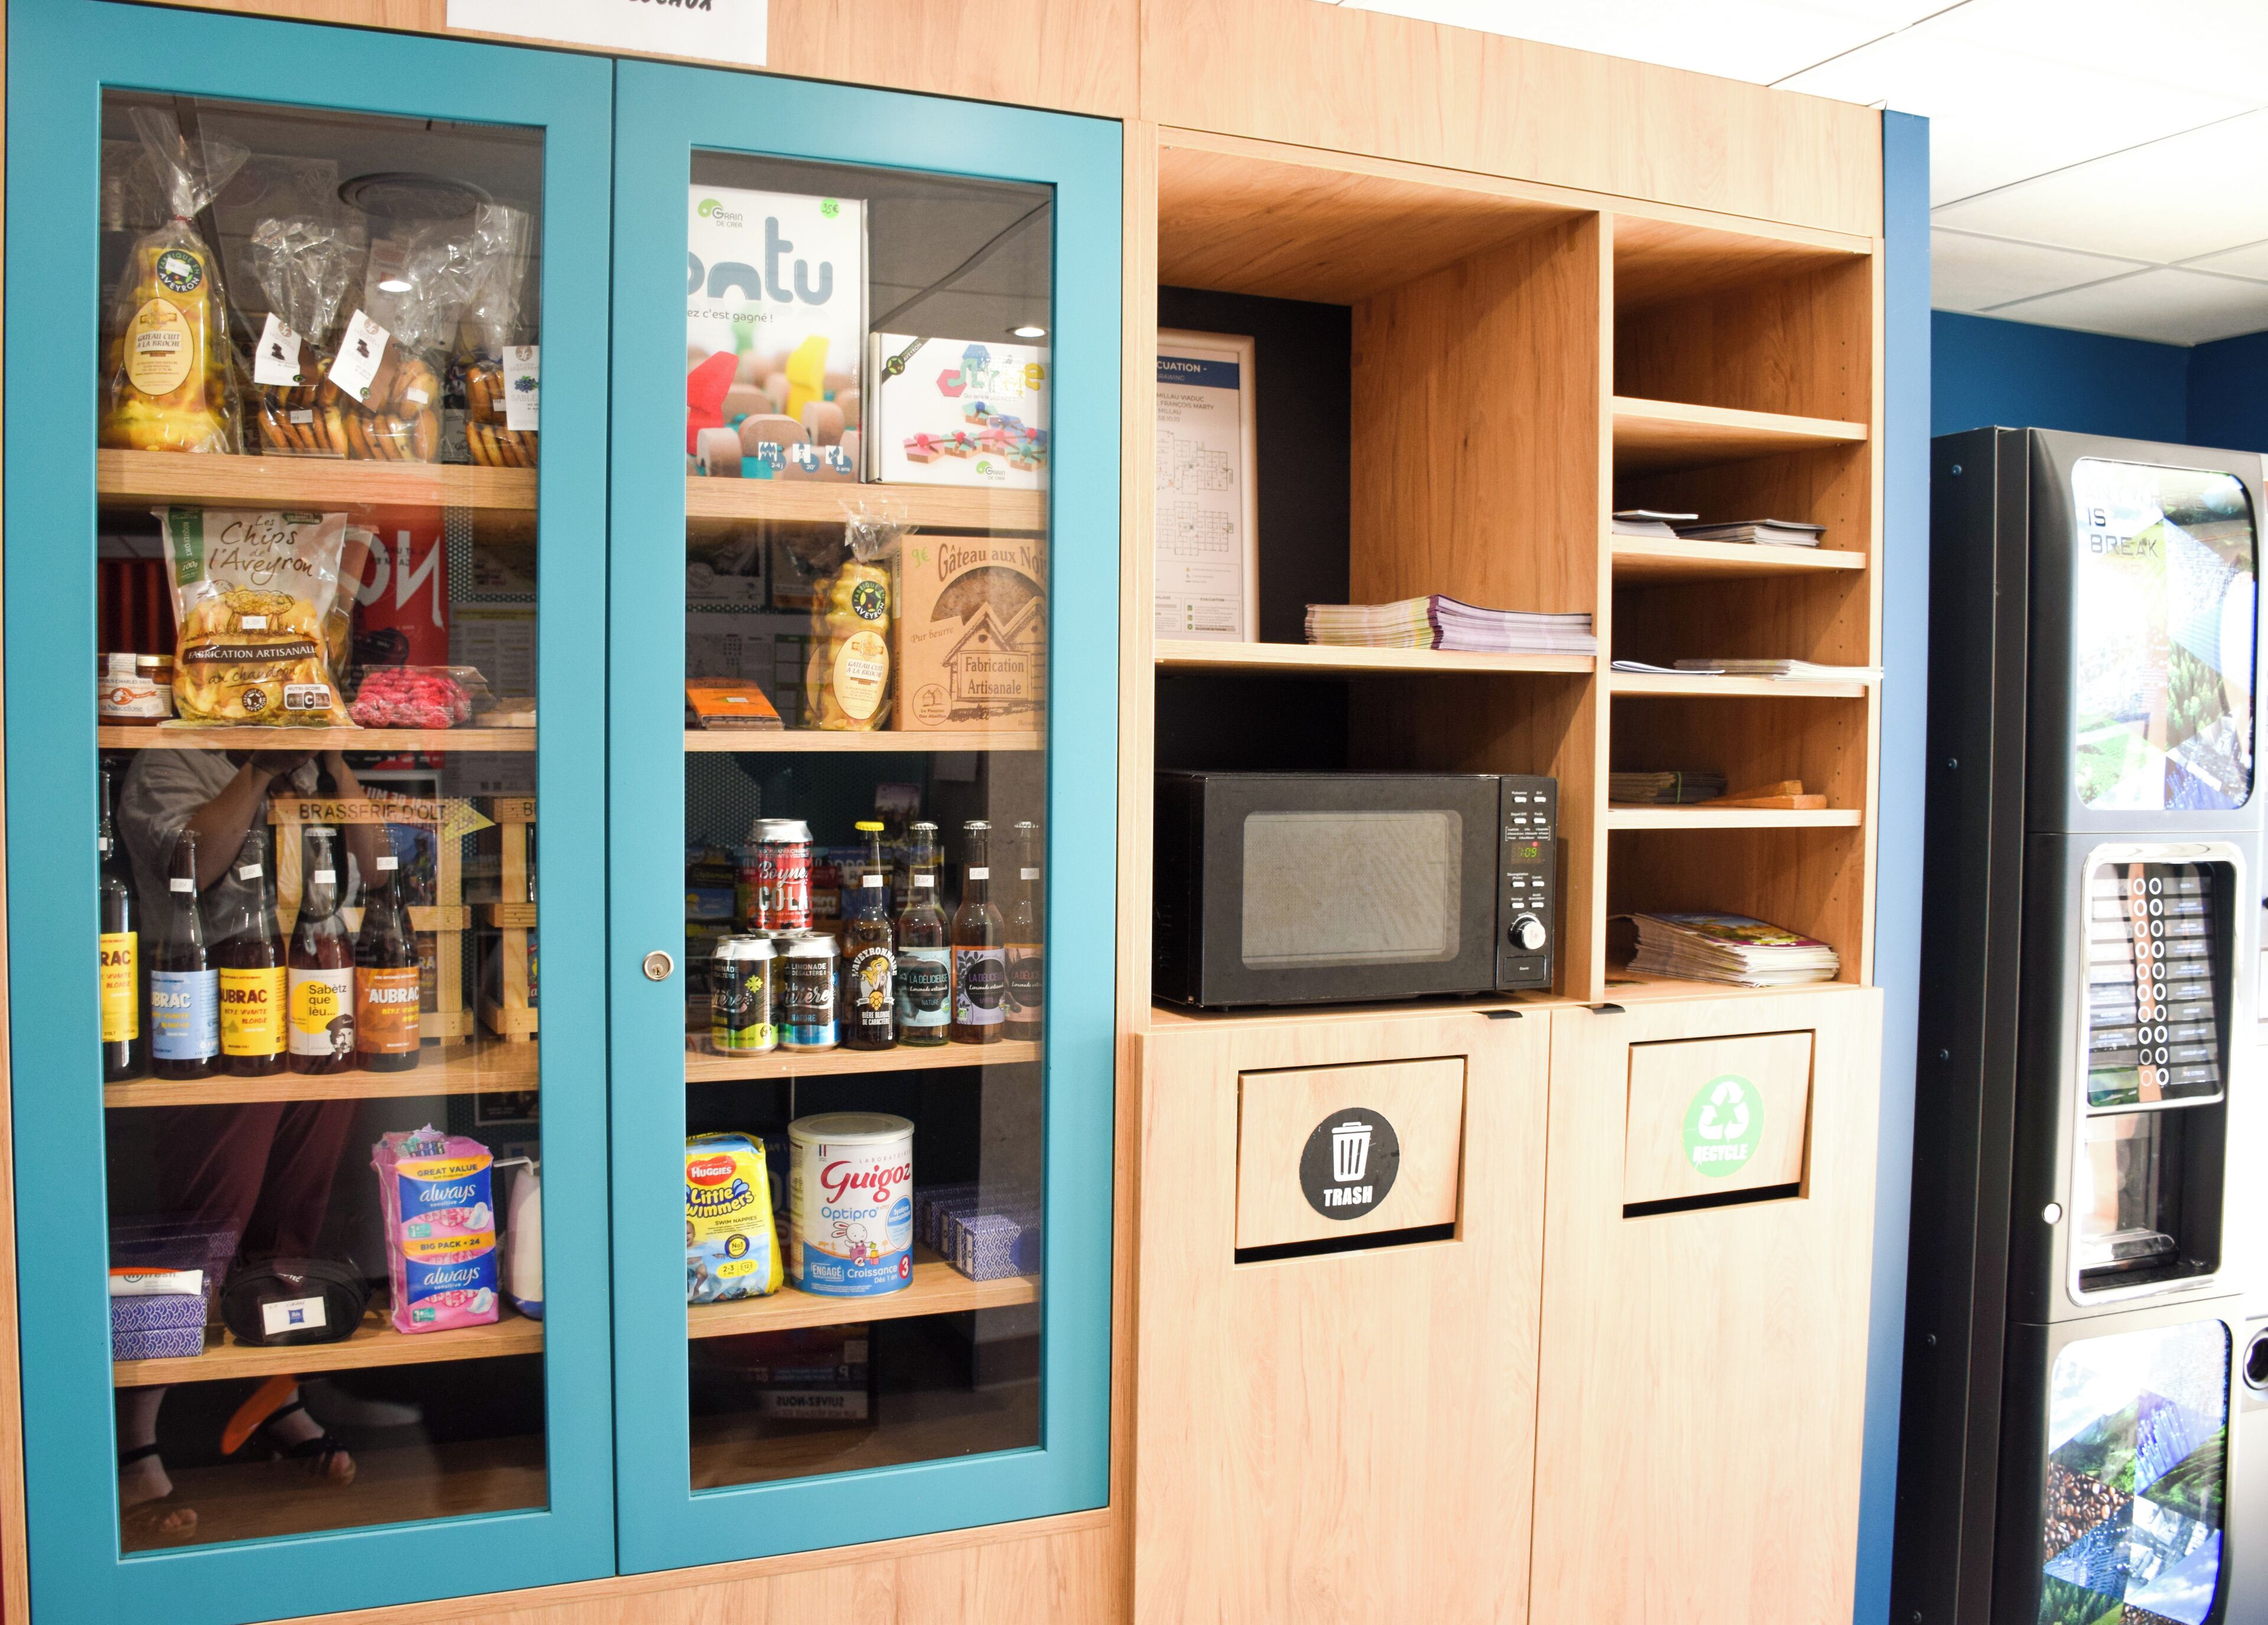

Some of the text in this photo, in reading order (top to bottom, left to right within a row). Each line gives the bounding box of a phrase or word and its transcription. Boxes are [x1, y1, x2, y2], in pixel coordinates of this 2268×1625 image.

[822, 203, 839, 214] 35€
[159, 273, 200, 292] AVEYRON
[703, 309, 729, 319] c'est
[733, 313, 767, 323] gagné
[138, 334, 180, 342] GATEAU CUIT
[255, 515, 275, 527] Les
[2087, 507, 2106, 527] IS
[221, 521, 298, 552] Chips
[250, 548, 265, 557] de
[2090, 534, 2159, 558] BREAK
[182, 561, 198, 572] 100g
[209, 547, 312, 586] l'Aveyron
[938, 543, 986, 582] Gâteau
[991, 550, 1016, 563] aux
[855, 602, 884, 620] AVEYRON
[911, 627, 954, 643] Pur beurre
[188, 649, 253, 660] FABRICATION
[966, 657, 1024, 673] Fabrication
[208, 664, 296, 684] au chaudron
[968, 679, 1021, 694] Artisanale
[305, 695, 314, 705] C
[299, 804, 447, 821] BRASSERIE D'OLT
[759, 886, 808, 911] COLA
[852, 947, 898, 977] L'AVEYRONNAISE
[910, 973, 948, 984] LA DÉLICIEUSE
[309, 984, 347, 995] Sabètz
[369, 987, 420, 1004] AUBRAC
[309, 996, 331, 1005] que
[309, 1007, 335, 1017] lèu...
[875, 1010, 890, 1019] BLONDE
[1693, 1143, 1748, 1163] RECYCLE
[417, 1164, 478, 1177] GREAT VALUE
[691, 1167, 732, 1177] HUGGIES
[820, 1160, 911, 1204] Guigoz
[419, 1183, 476, 1204] always
[691, 1188, 734, 1205] Little
[1324, 1186, 1373, 1207] TRASH
[733, 1215, 757, 1224] NAPPIES
[821, 1206, 877, 1222] Optipro
[421, 1238, 480, 1251] BIG PACK 24
[813, 1265, 842, 1277] ENGAGÉ
[847, 1257, 908, 1278] Croissance 3
[423, 1267, 481, 1287] always
